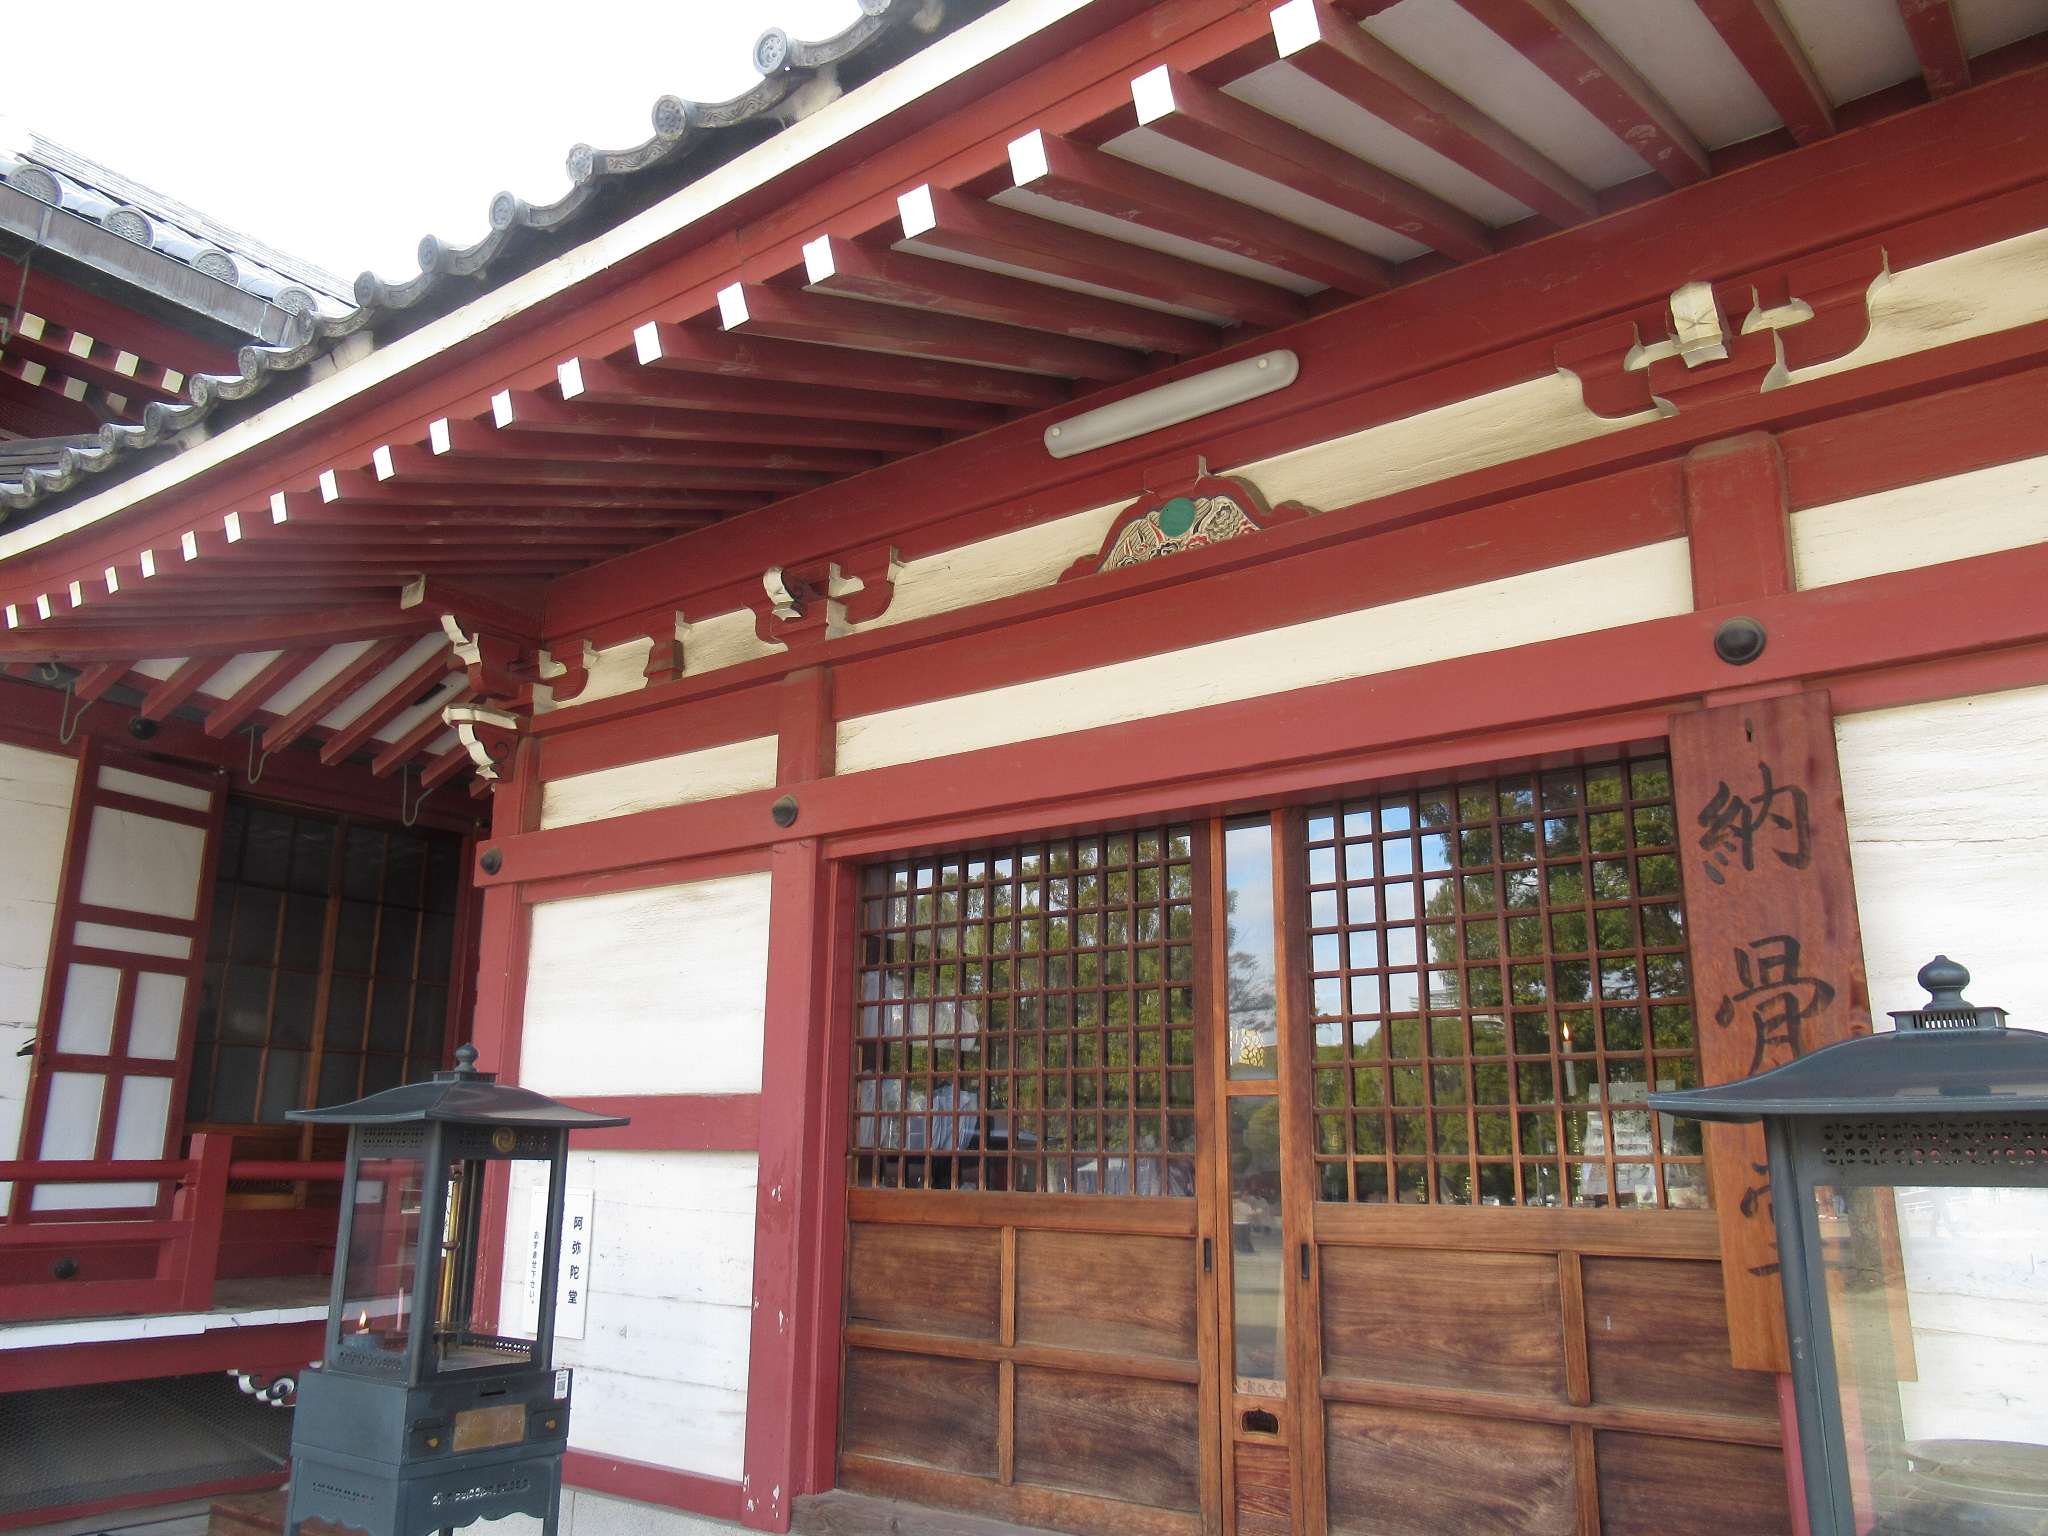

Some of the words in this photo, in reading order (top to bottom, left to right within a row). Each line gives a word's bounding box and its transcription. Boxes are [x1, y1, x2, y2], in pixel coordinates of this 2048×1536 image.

[1697, 760, 1836, 1277] 納骨
[567, 1216, 584, 1304] 阿弥陀堂
